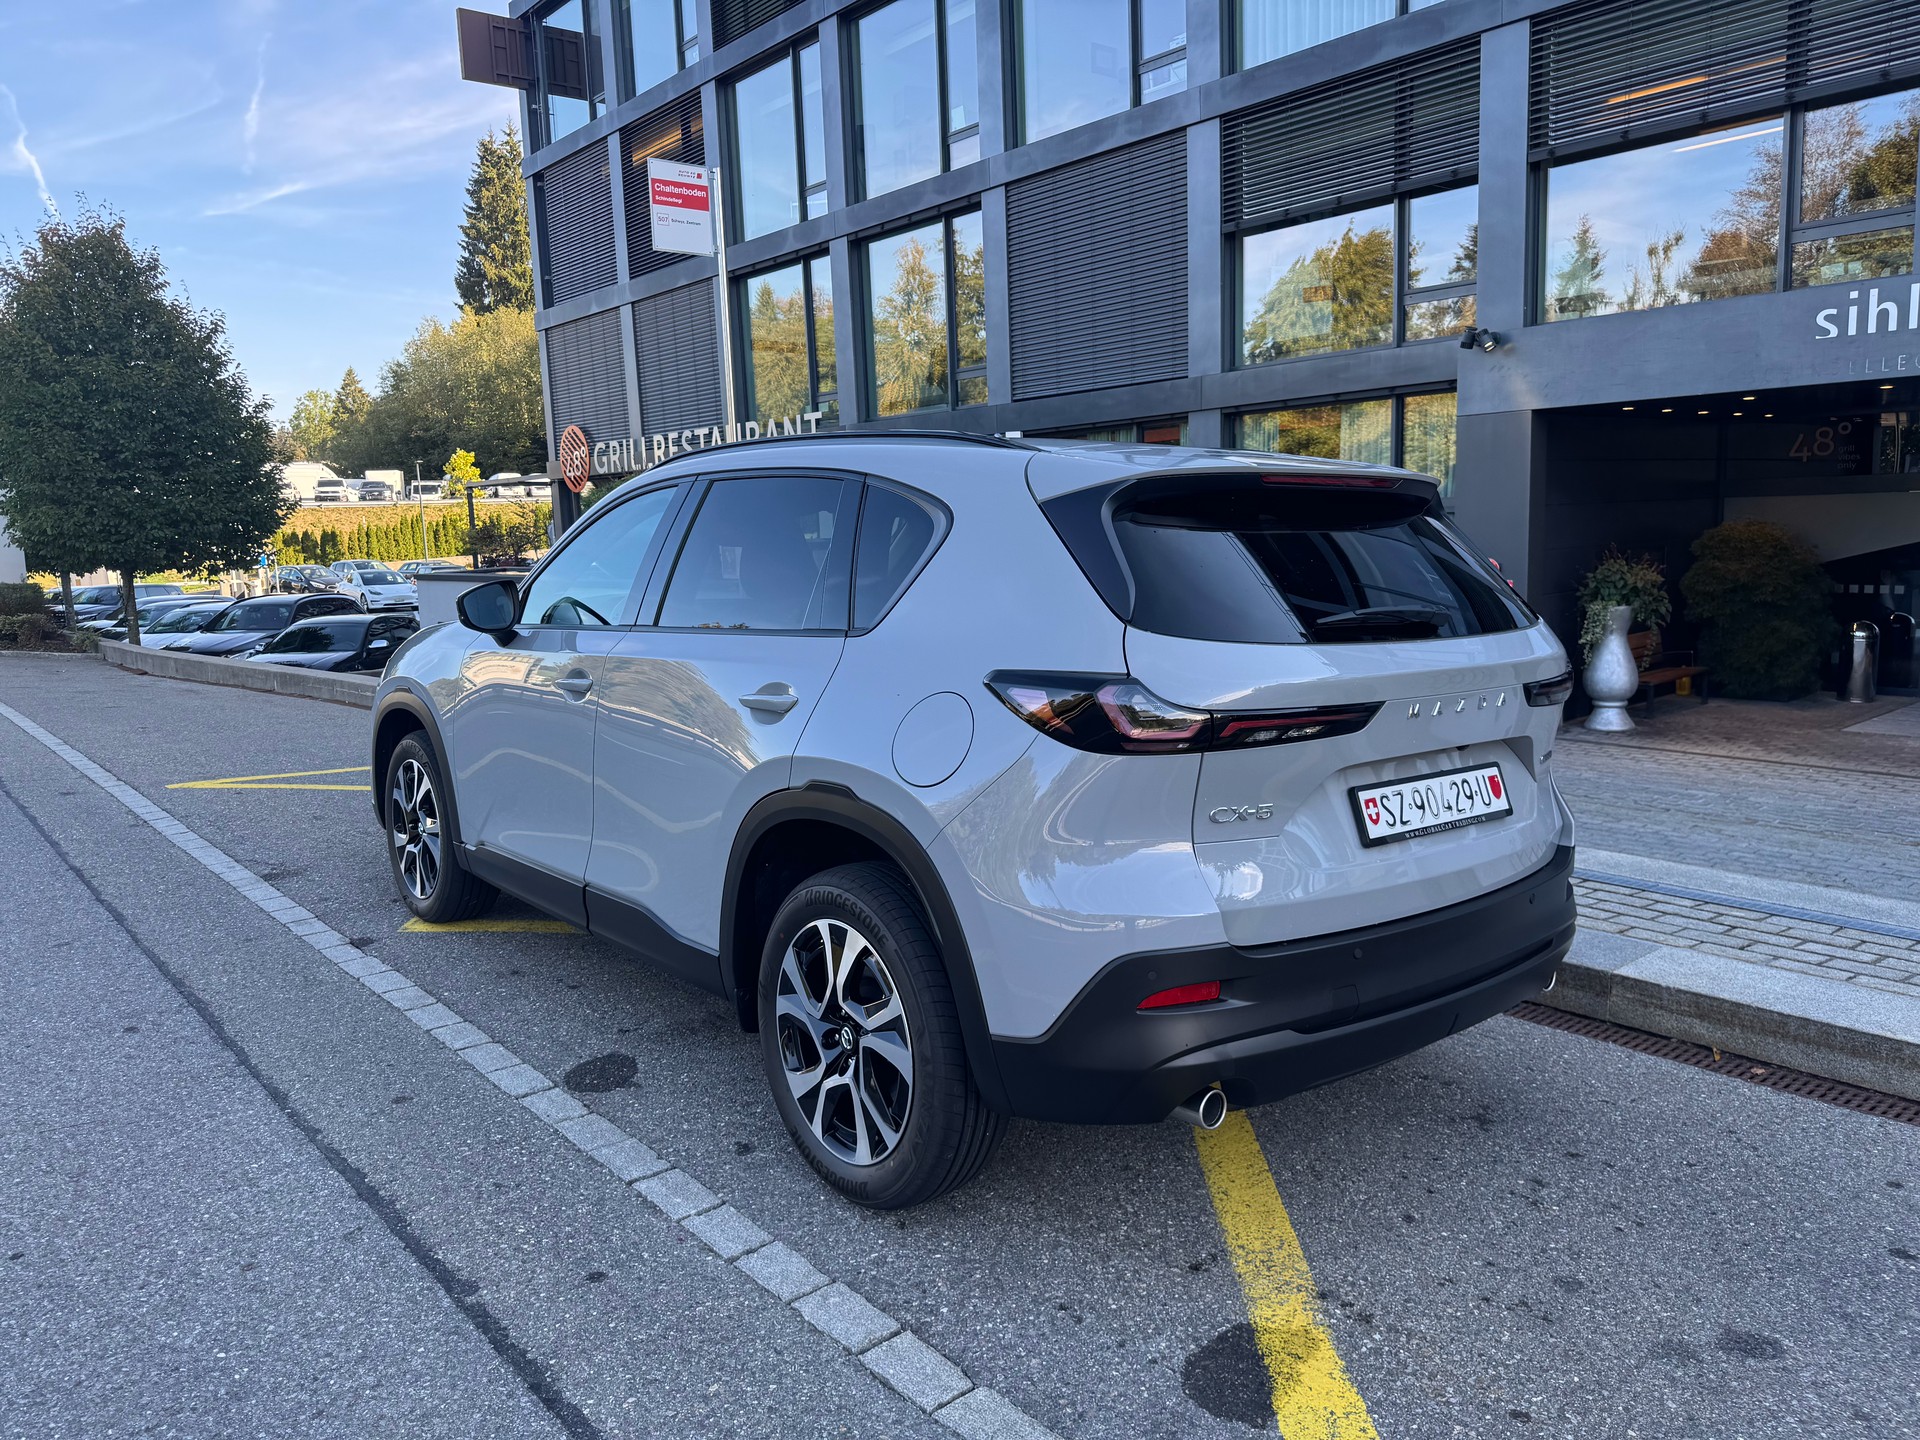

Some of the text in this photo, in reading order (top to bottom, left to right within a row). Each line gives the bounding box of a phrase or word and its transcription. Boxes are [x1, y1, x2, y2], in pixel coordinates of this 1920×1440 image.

[654, 183, 707, 198] Chaltenboden
[1407, 692, 1506, 720] MAZDA
[1208, 803, 1274, 824] CX-5
[804, 889, 889, 947] BRIDGESTONE
